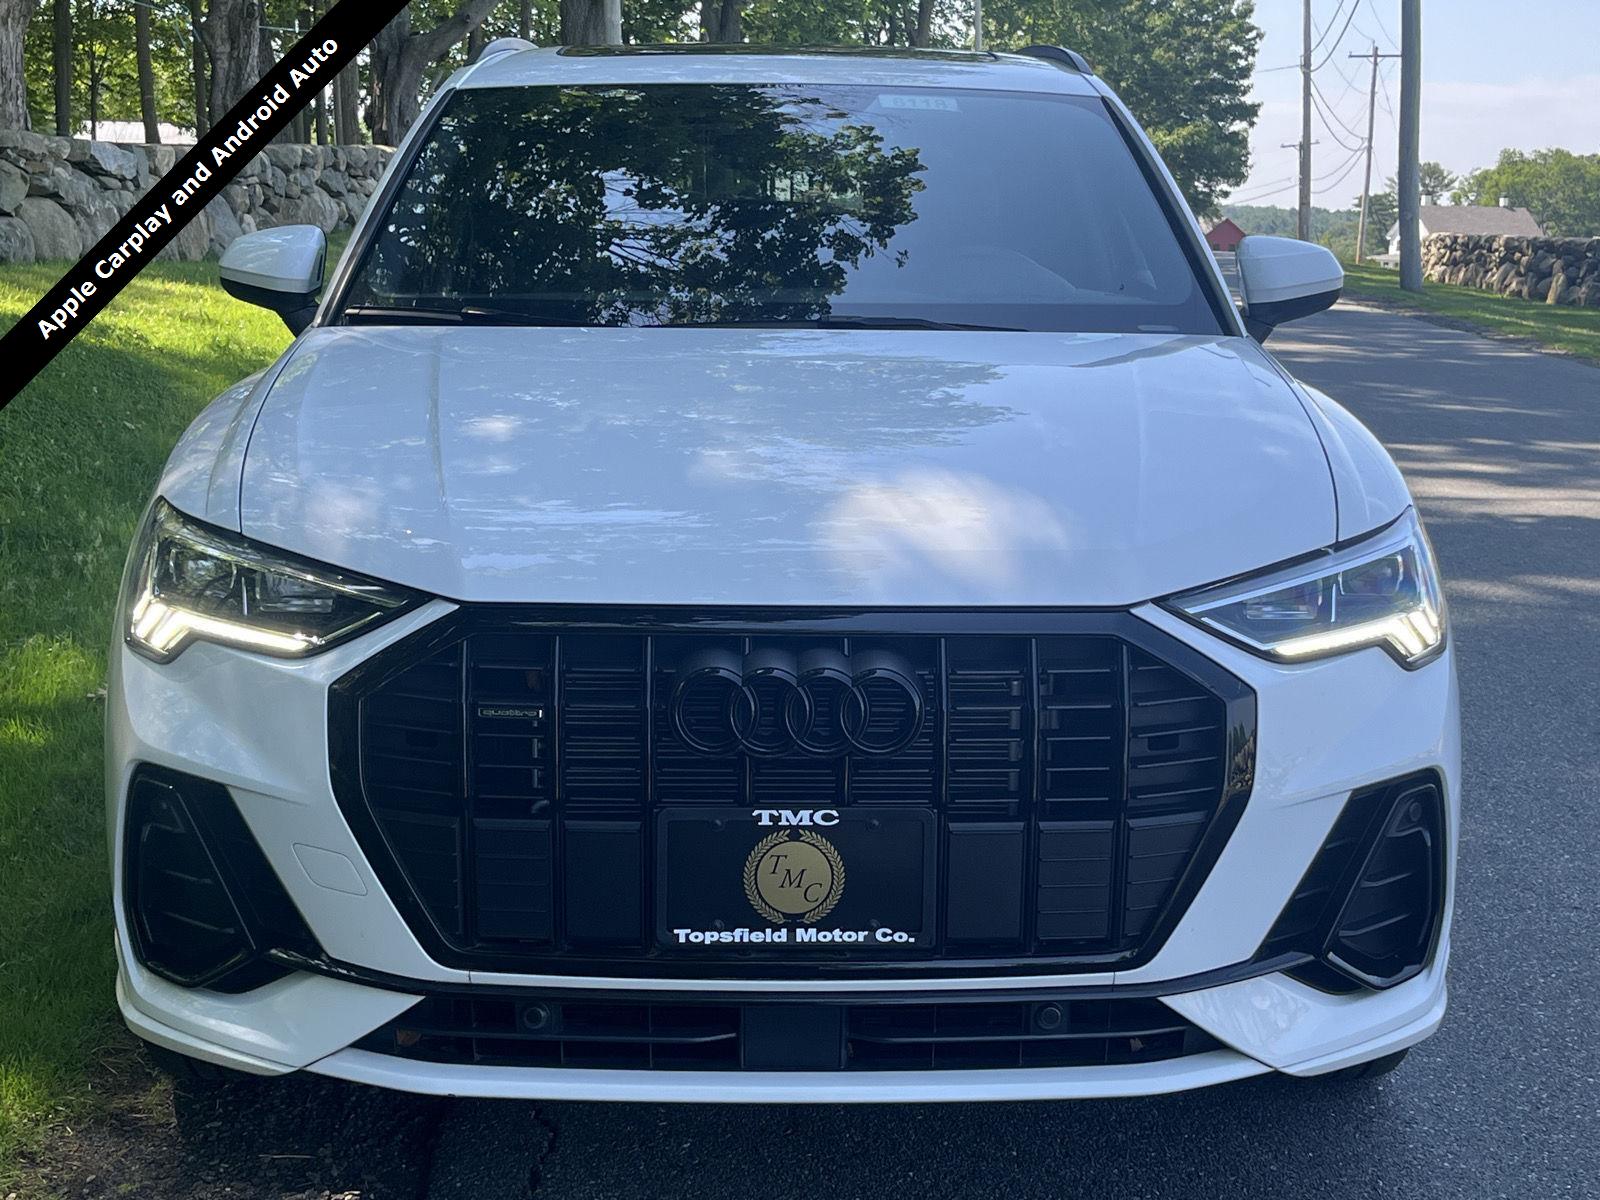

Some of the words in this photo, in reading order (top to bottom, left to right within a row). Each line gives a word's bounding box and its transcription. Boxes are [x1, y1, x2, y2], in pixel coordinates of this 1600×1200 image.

[482, 709, 538, 718] quattro
[752, 809, 840, 826] TMC
[769, 854, 822, 903] TMC
[673, 928, 788, 944] Topsfield
[795, 928, 869, 943] Motor
[875, 928, 915, 943] Co.
